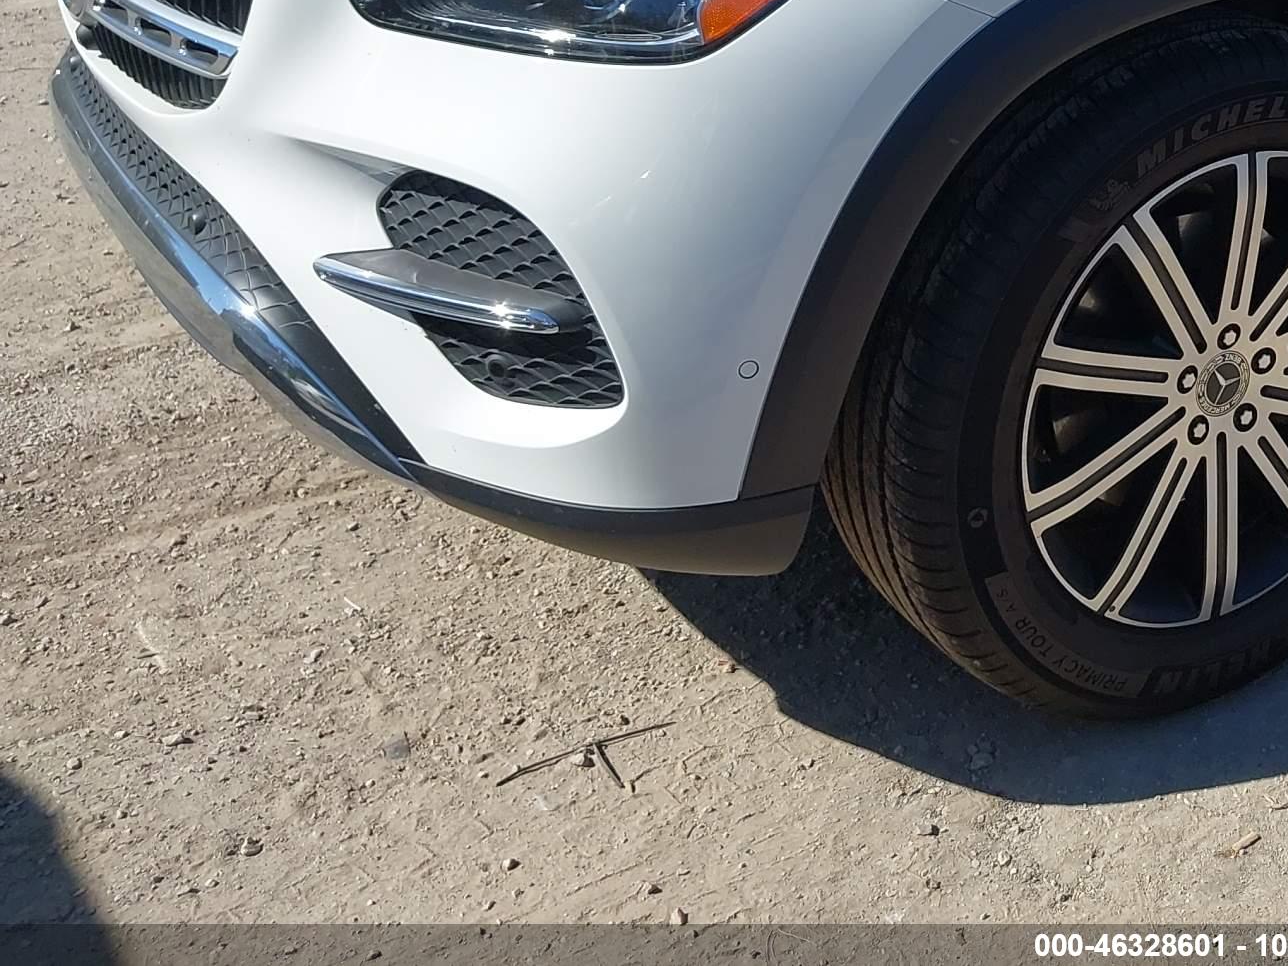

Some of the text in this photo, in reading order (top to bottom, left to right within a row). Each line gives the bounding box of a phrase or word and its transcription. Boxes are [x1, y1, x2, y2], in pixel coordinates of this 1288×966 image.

[1224, 354, 1242, 364] BENZ
[1200, 397, 1231, 413] MERCEDES
[1015, 617, 1055, 658] TOUR
[1053, 655, 1127, 692] PRIMACY
